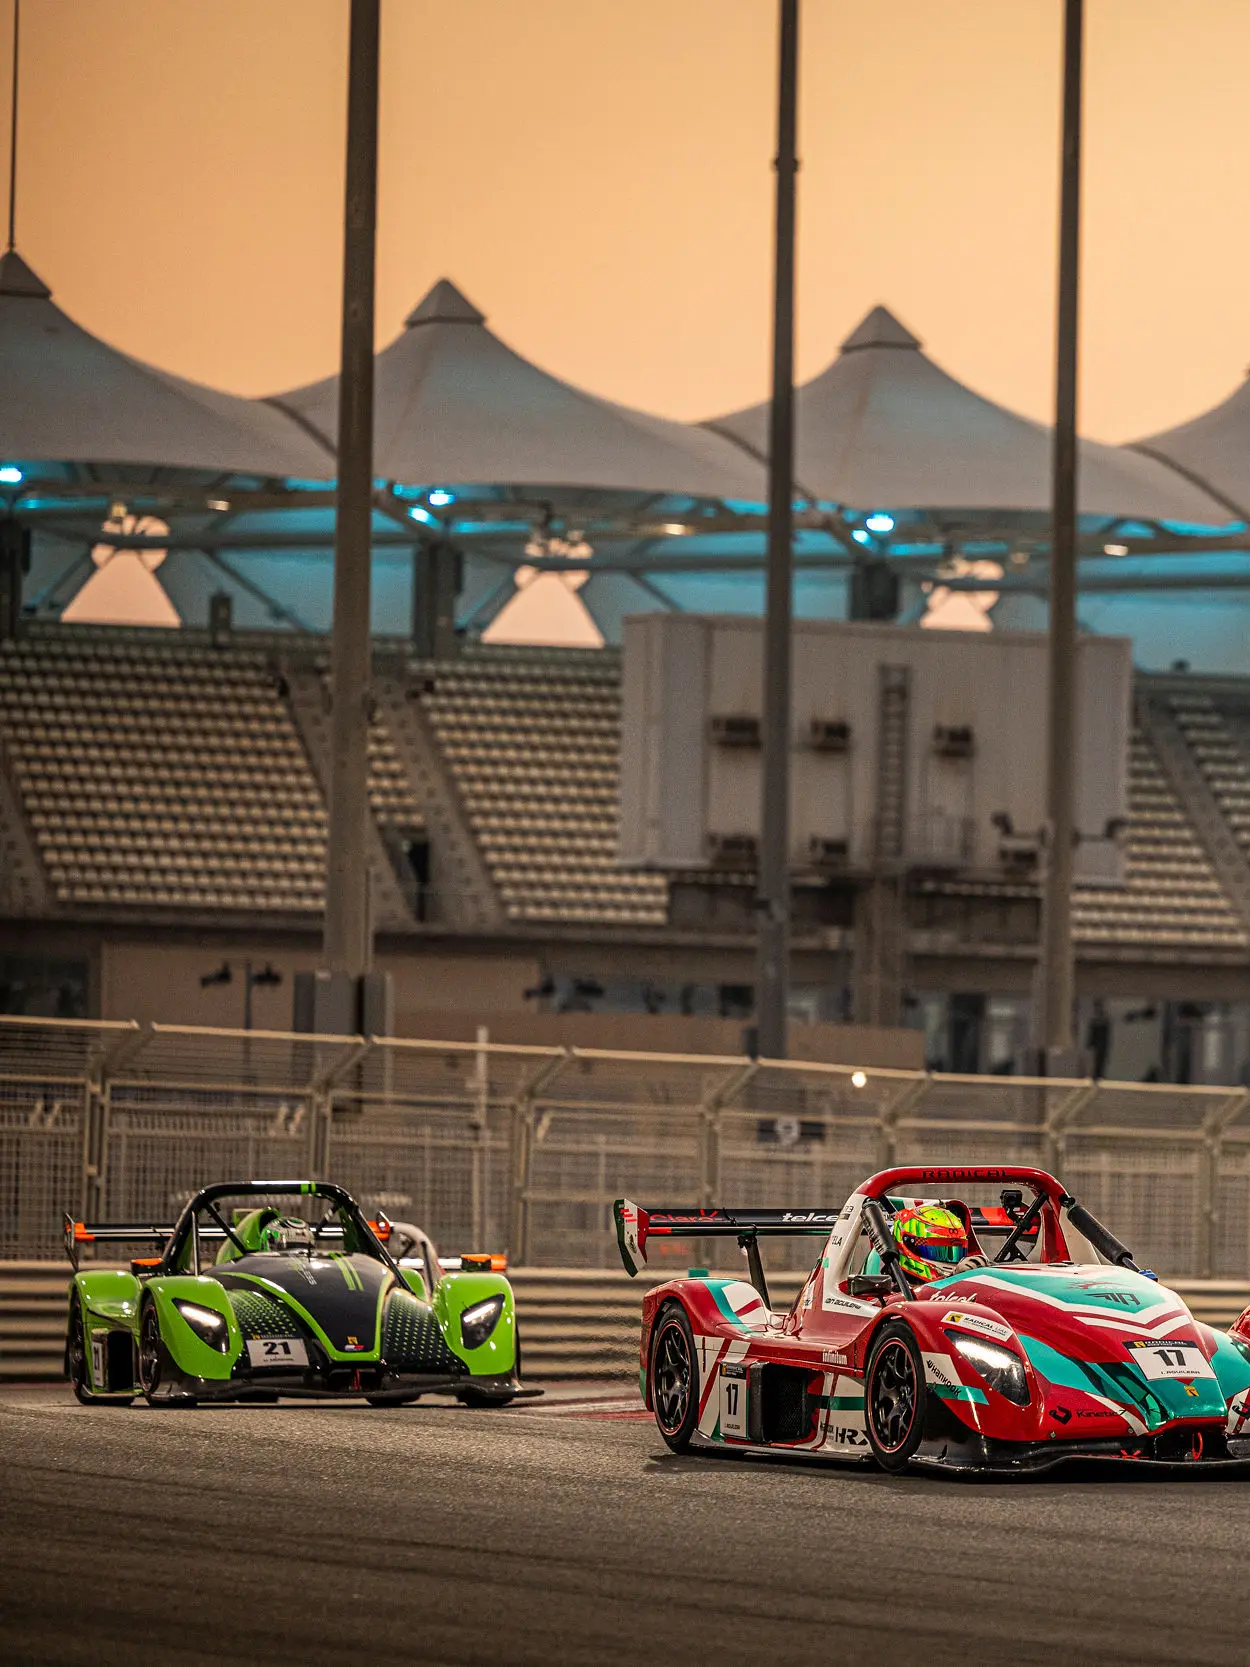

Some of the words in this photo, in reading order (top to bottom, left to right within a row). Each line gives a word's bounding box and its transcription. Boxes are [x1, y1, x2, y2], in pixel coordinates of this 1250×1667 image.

[922, 1169, 1006, 1179] RADICAL
[650, 1209, 718, 1223] Claro
[782, 1212, 840, 1222] telce
[262, 1341, 292, 1355] 21
[1153, 1349, 1187, 1367] 17
[726, 1383, 739, 1416] 17
